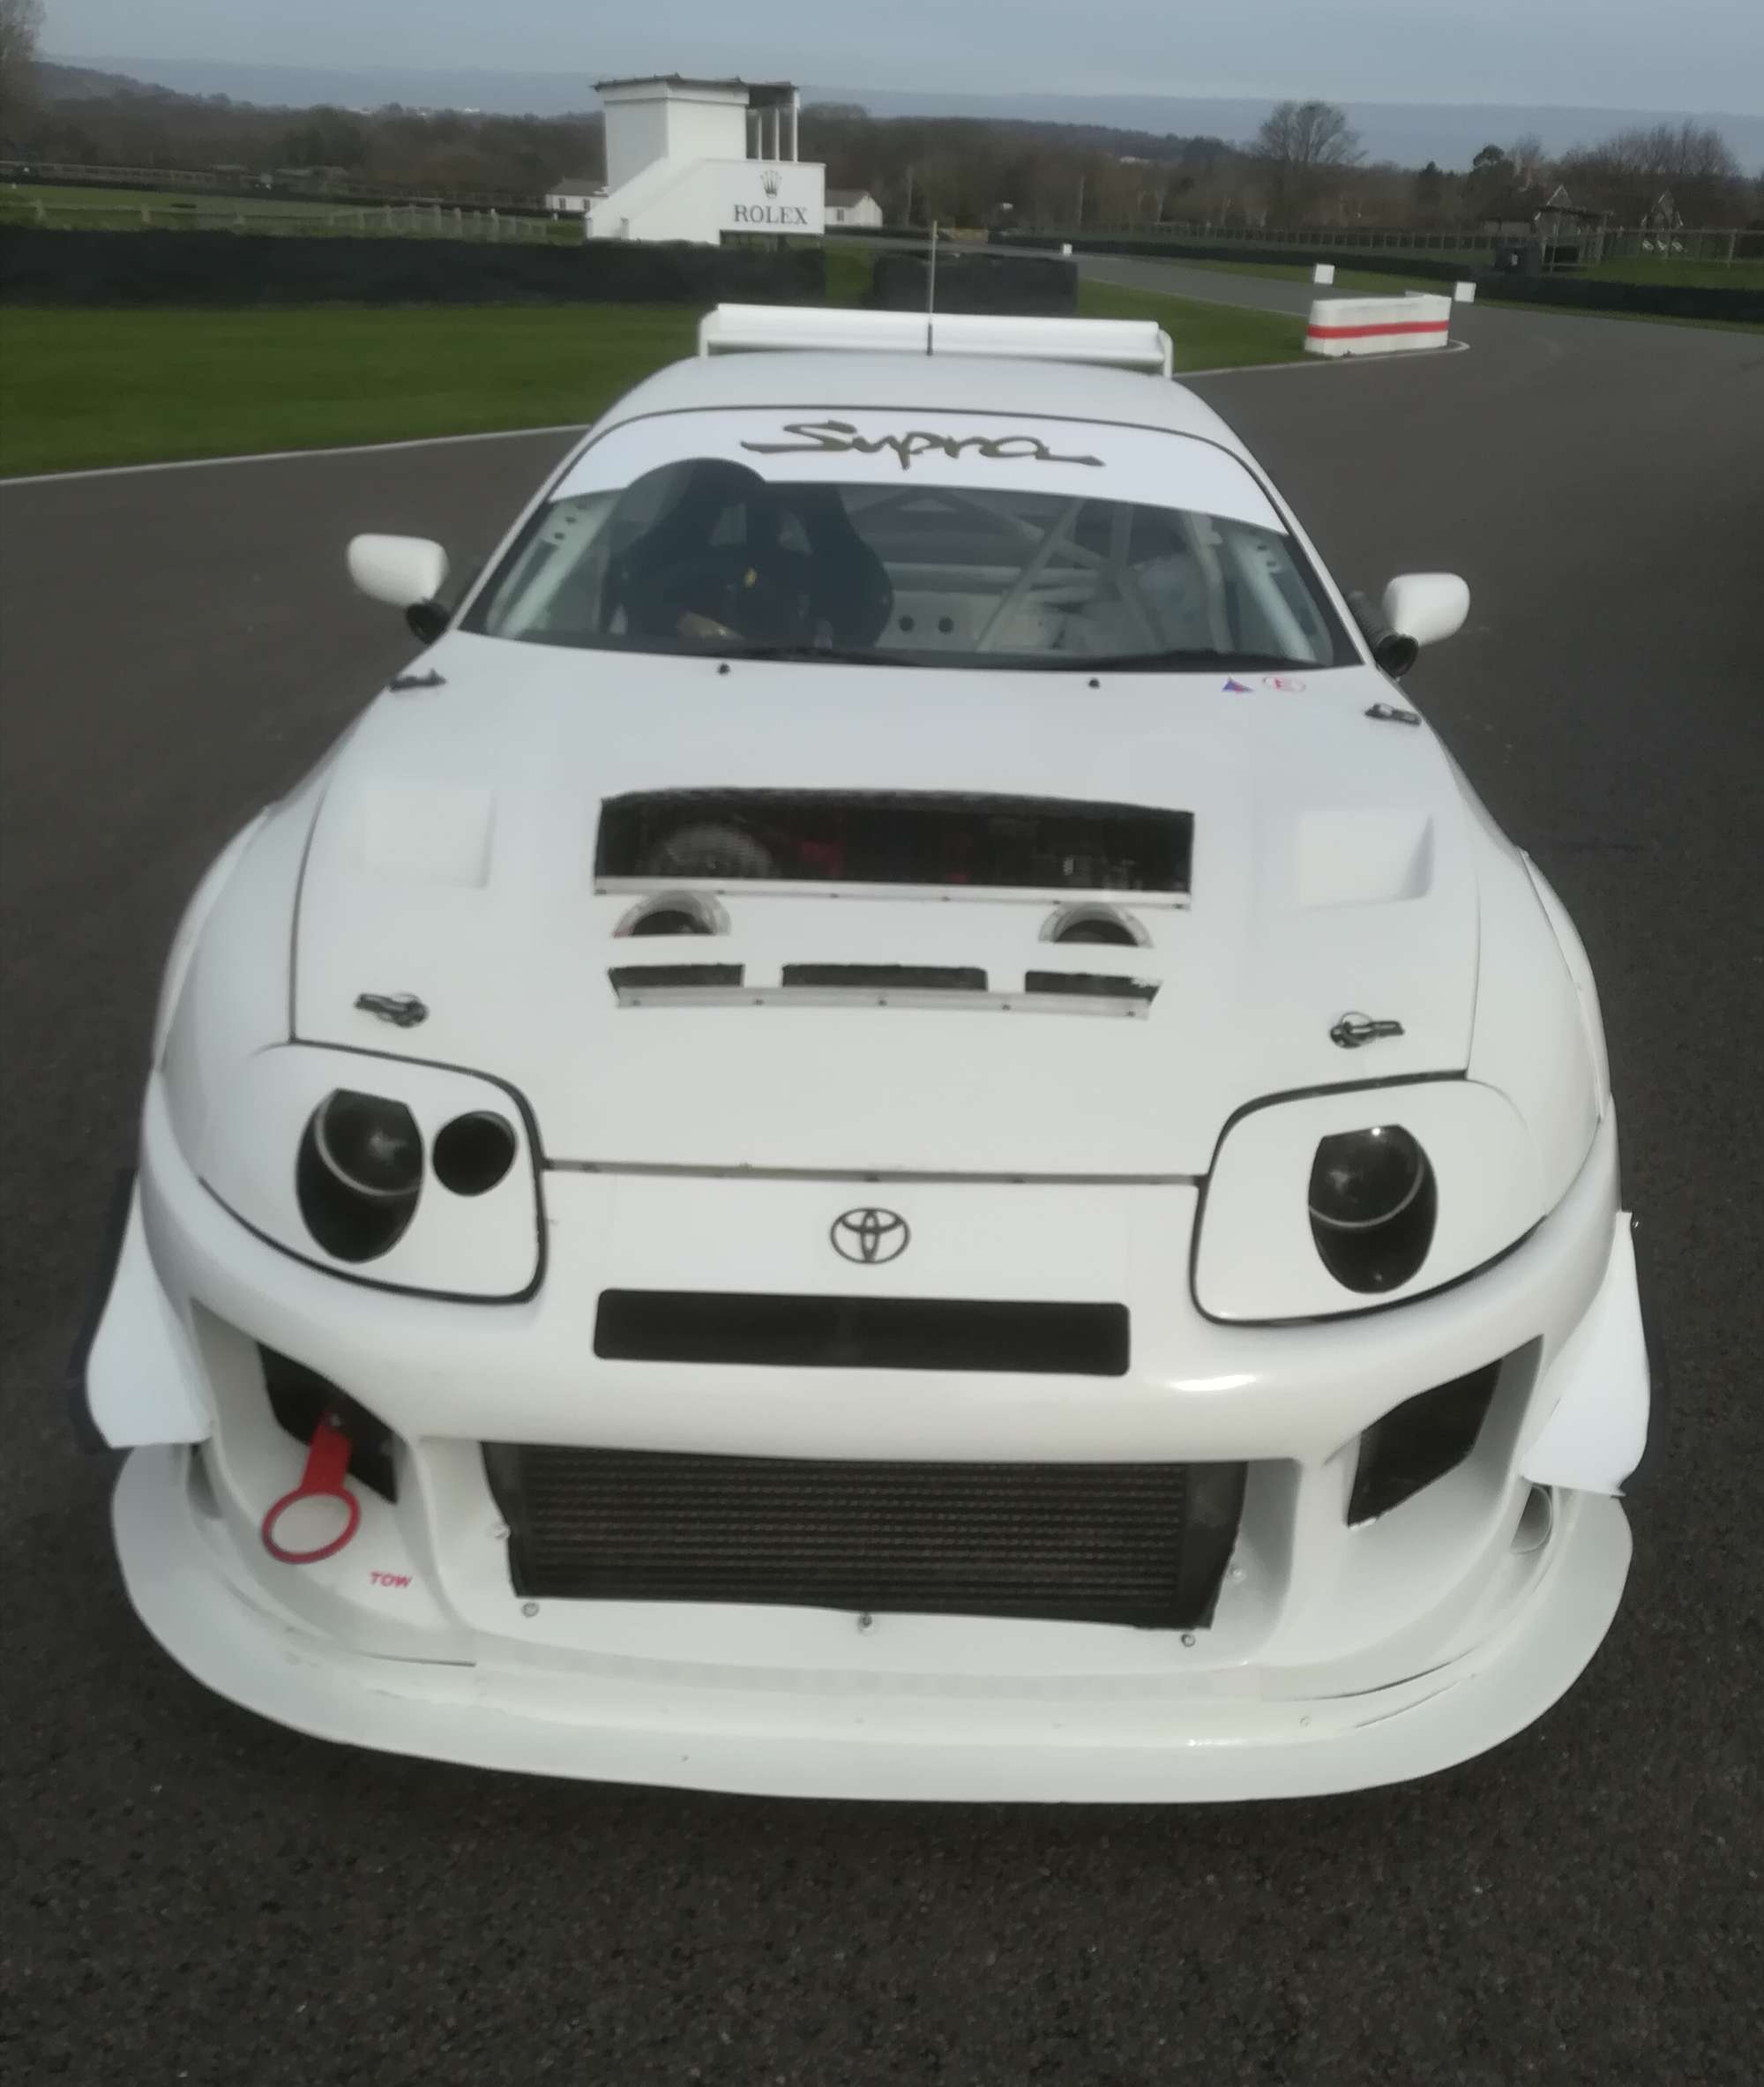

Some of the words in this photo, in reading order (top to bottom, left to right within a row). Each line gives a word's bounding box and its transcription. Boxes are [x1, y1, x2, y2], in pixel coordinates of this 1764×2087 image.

[734, 204, 808, 225] ROLEX
[740, 420, 1105, 470] Supra
[370, 1571, 413, 1588] TOW
